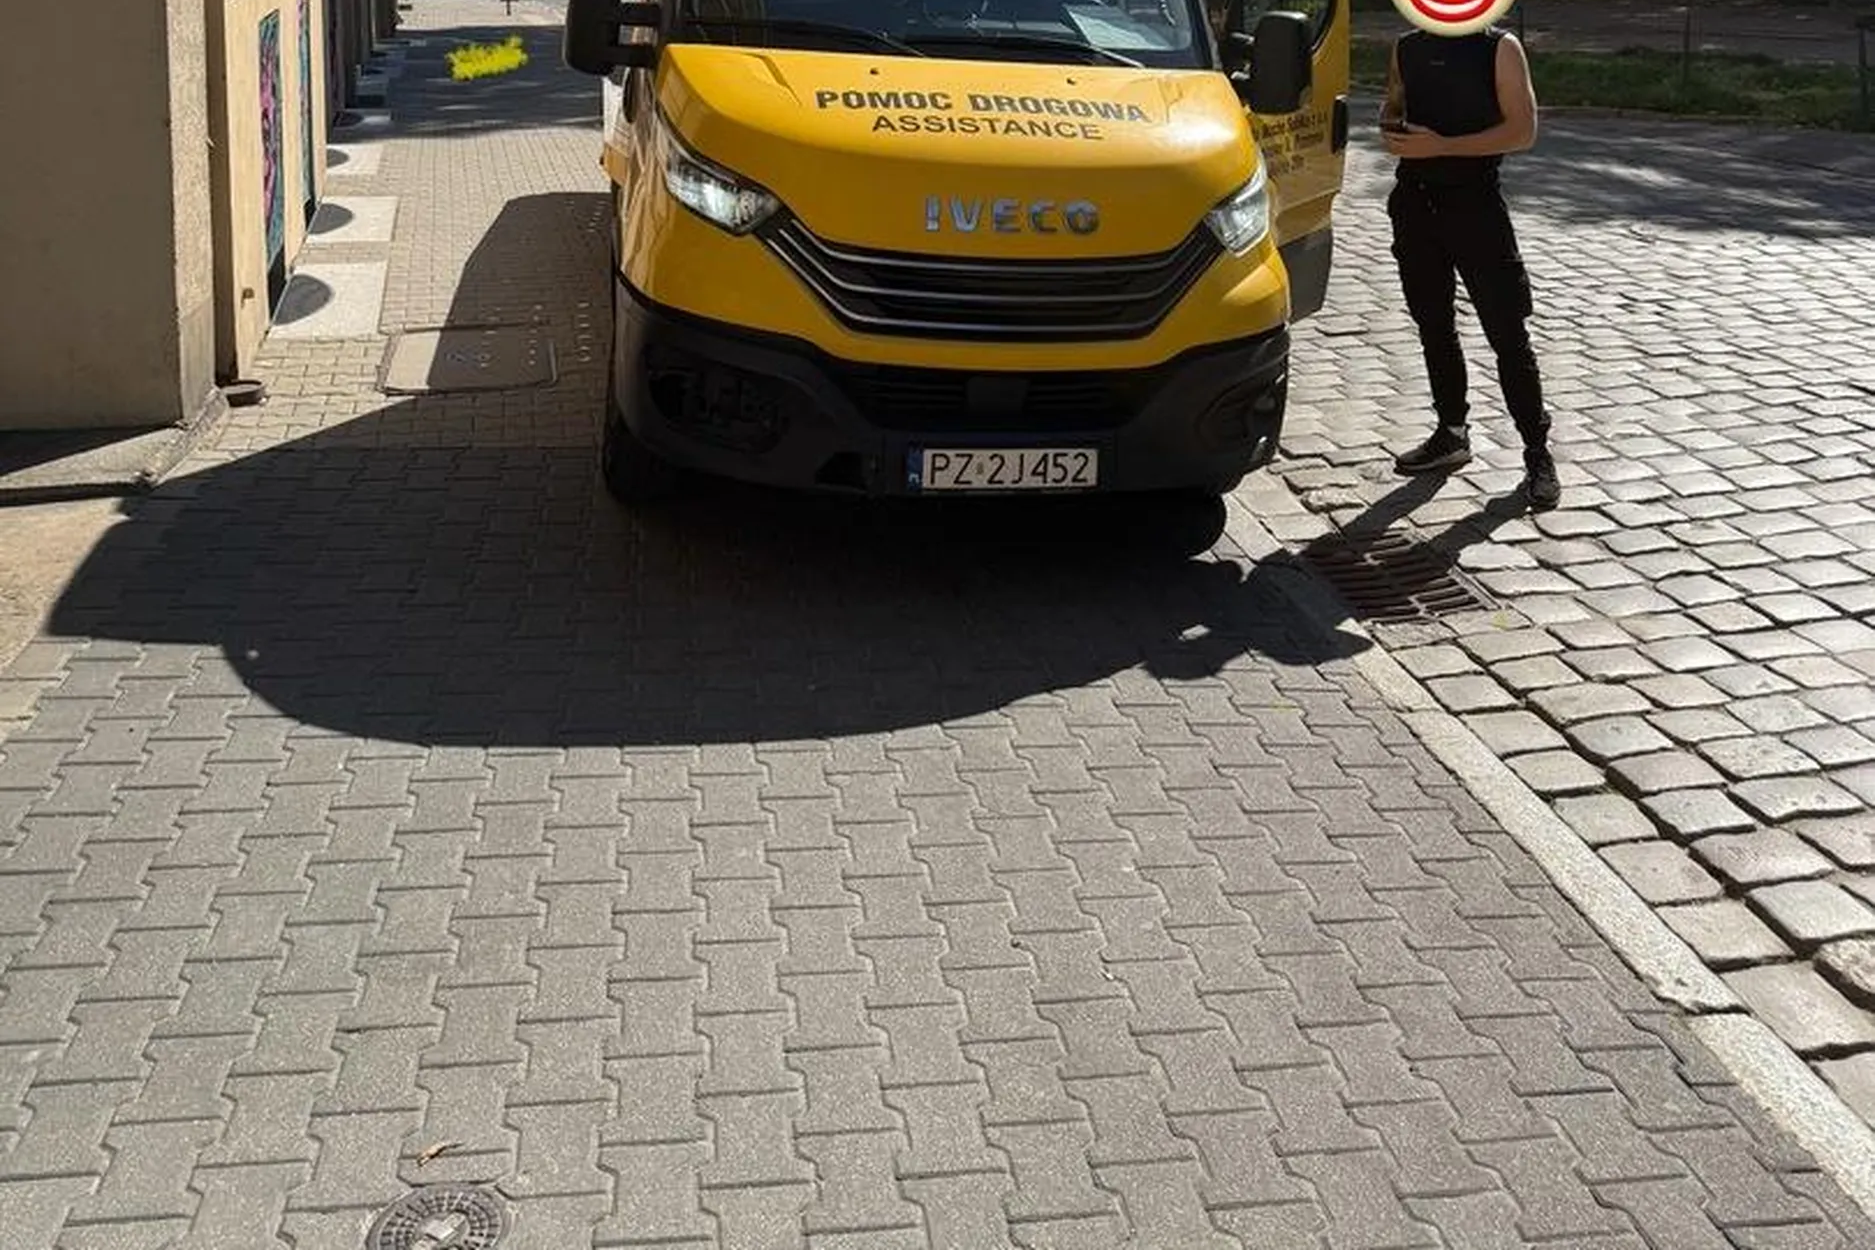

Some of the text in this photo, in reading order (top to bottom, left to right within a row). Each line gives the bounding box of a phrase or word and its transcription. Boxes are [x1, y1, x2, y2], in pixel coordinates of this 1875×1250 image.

[816, 90, 1152, 123] POMOC DROGOWA
[872, 114, 1105, 142] ASSISTANCE
[924, 194, 1100, 235] IVECO
[930, 452, 1090, 485] PZ 2J452
